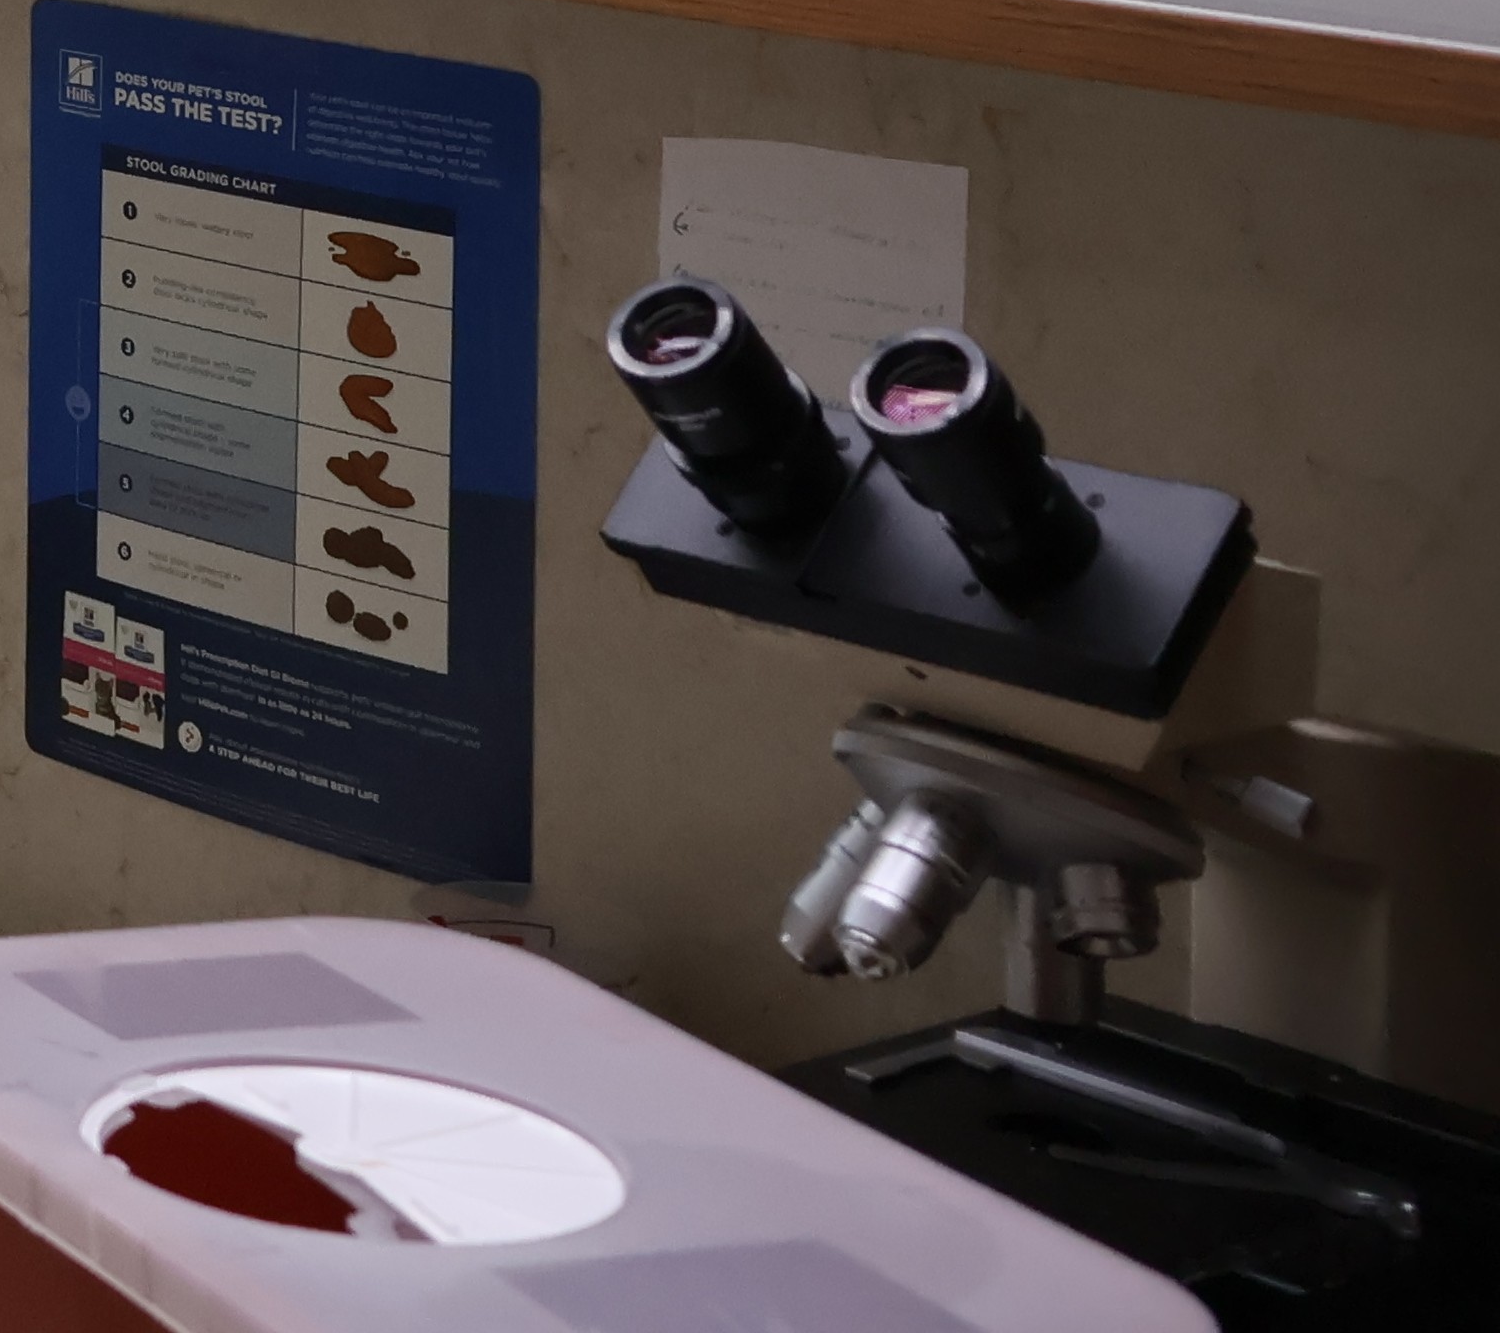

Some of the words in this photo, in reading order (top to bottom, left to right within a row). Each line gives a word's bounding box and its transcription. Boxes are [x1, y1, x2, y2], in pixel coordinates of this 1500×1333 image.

[114, 71, 148, 87] DOES
[151, 77, 185, 95] YOUR
[187, 83, 223, 100] PET'S
[225, 89, 268, 110] STOOL
[113, 87, 166, 115] PASS
[170, 97, 213, 124] THE
[217, 105, 283, 136] TEST?
[126, 155, 167, 175] STOOL
[170, 163, 229, 187] GRADING
[232, 175, 277, 196] CHART
[330, 779, 357, 797] BEST
[357, 789, 381, 805] LIFE
